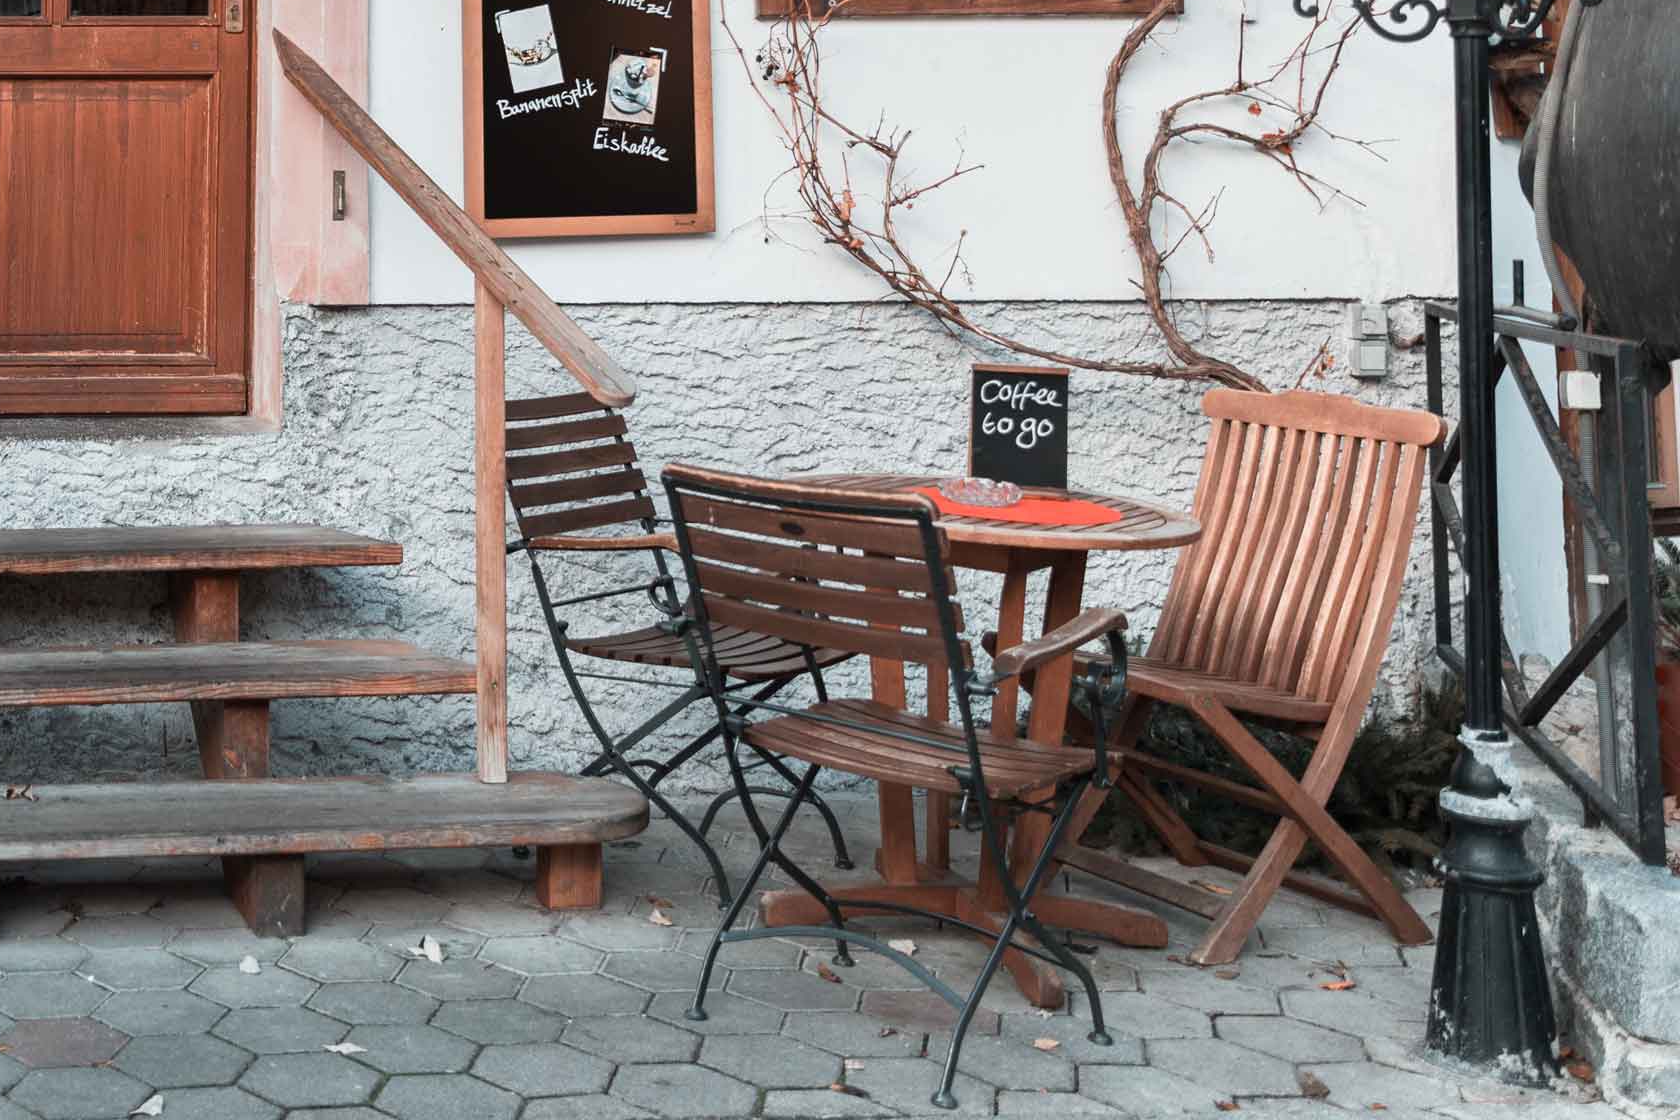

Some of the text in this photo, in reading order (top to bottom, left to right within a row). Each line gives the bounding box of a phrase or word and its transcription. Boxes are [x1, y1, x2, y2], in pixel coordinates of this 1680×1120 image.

[496, 78, 597, 119] Bananensplit
[980, 379, 1064, 411] Coffee
[981, 411, 1055, 449] to go
